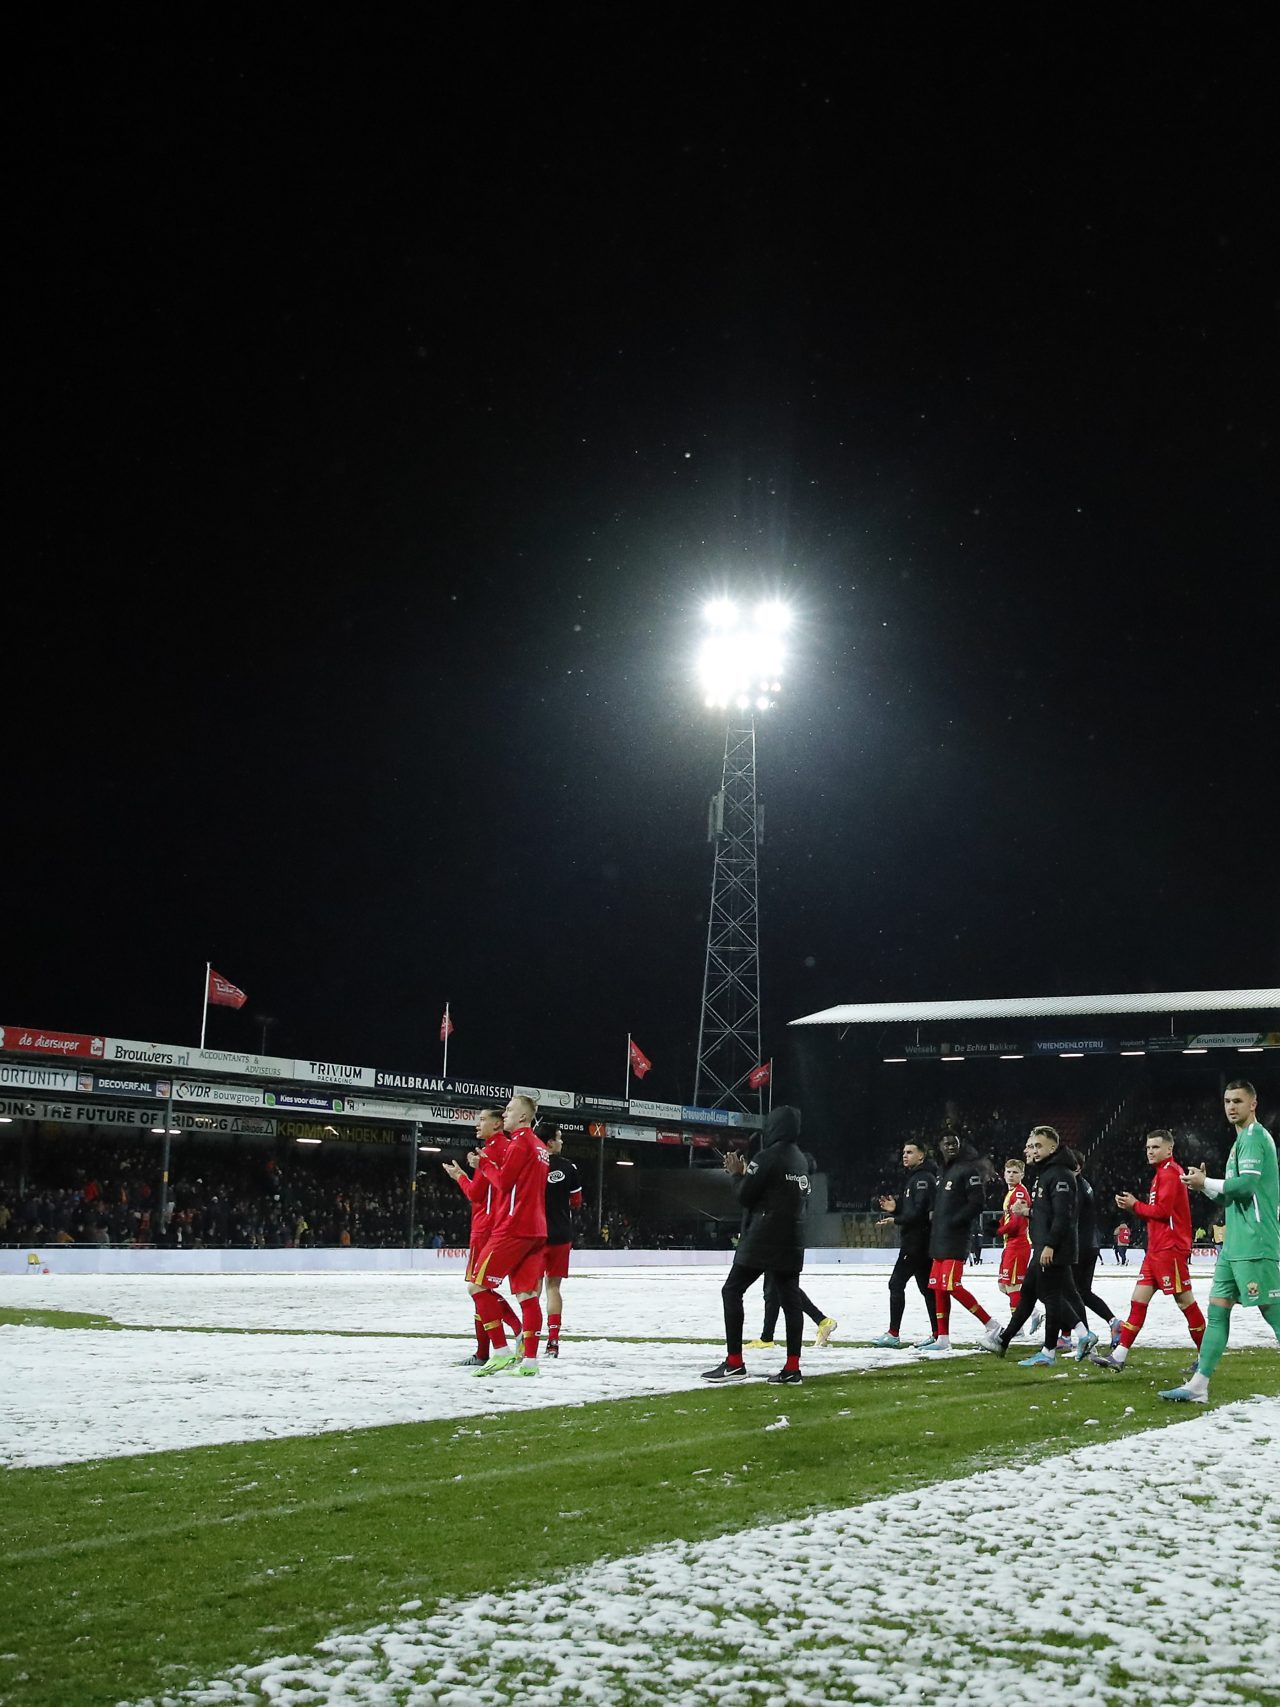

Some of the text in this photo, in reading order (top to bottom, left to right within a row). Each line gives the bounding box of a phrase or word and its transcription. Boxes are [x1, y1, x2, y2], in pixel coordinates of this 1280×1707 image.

[18, 1032, 80, 1054] de diersuper
[954, 1043, 965, 1052] De
[966, 1043, 988, 1052] Echte
[1037, 1041, 1104, 1049] VRIENDENLOTERIJ
[114, 1045, 173, 1064] Brouwers
[199, 1050, 259, 1064] ACCOUNTANTS &
[245, 1065, 281, 1076] ADVISEURS
[309, 1062, 362, 1079] TRIVIUM
[98, 1079, 152, 1092] DECOVERF.NL
[377, 1073, 444, 1091] SMALBRAAK
[455, 1081, 512, 1099] NOTARISSEN
[188, 1085, 260, 1105] VDR Bouwgroep
[280, 1094, 293, 1103] Kies
[294, 1096, 308, 1104] voor
[43, 1104, 72, 1119] THE
[77, 1107, 135, 1124] FUTURE
[140, 1112, 158, 1124] OF
[431, 1106, 476, 1121] VALIDSIGN
